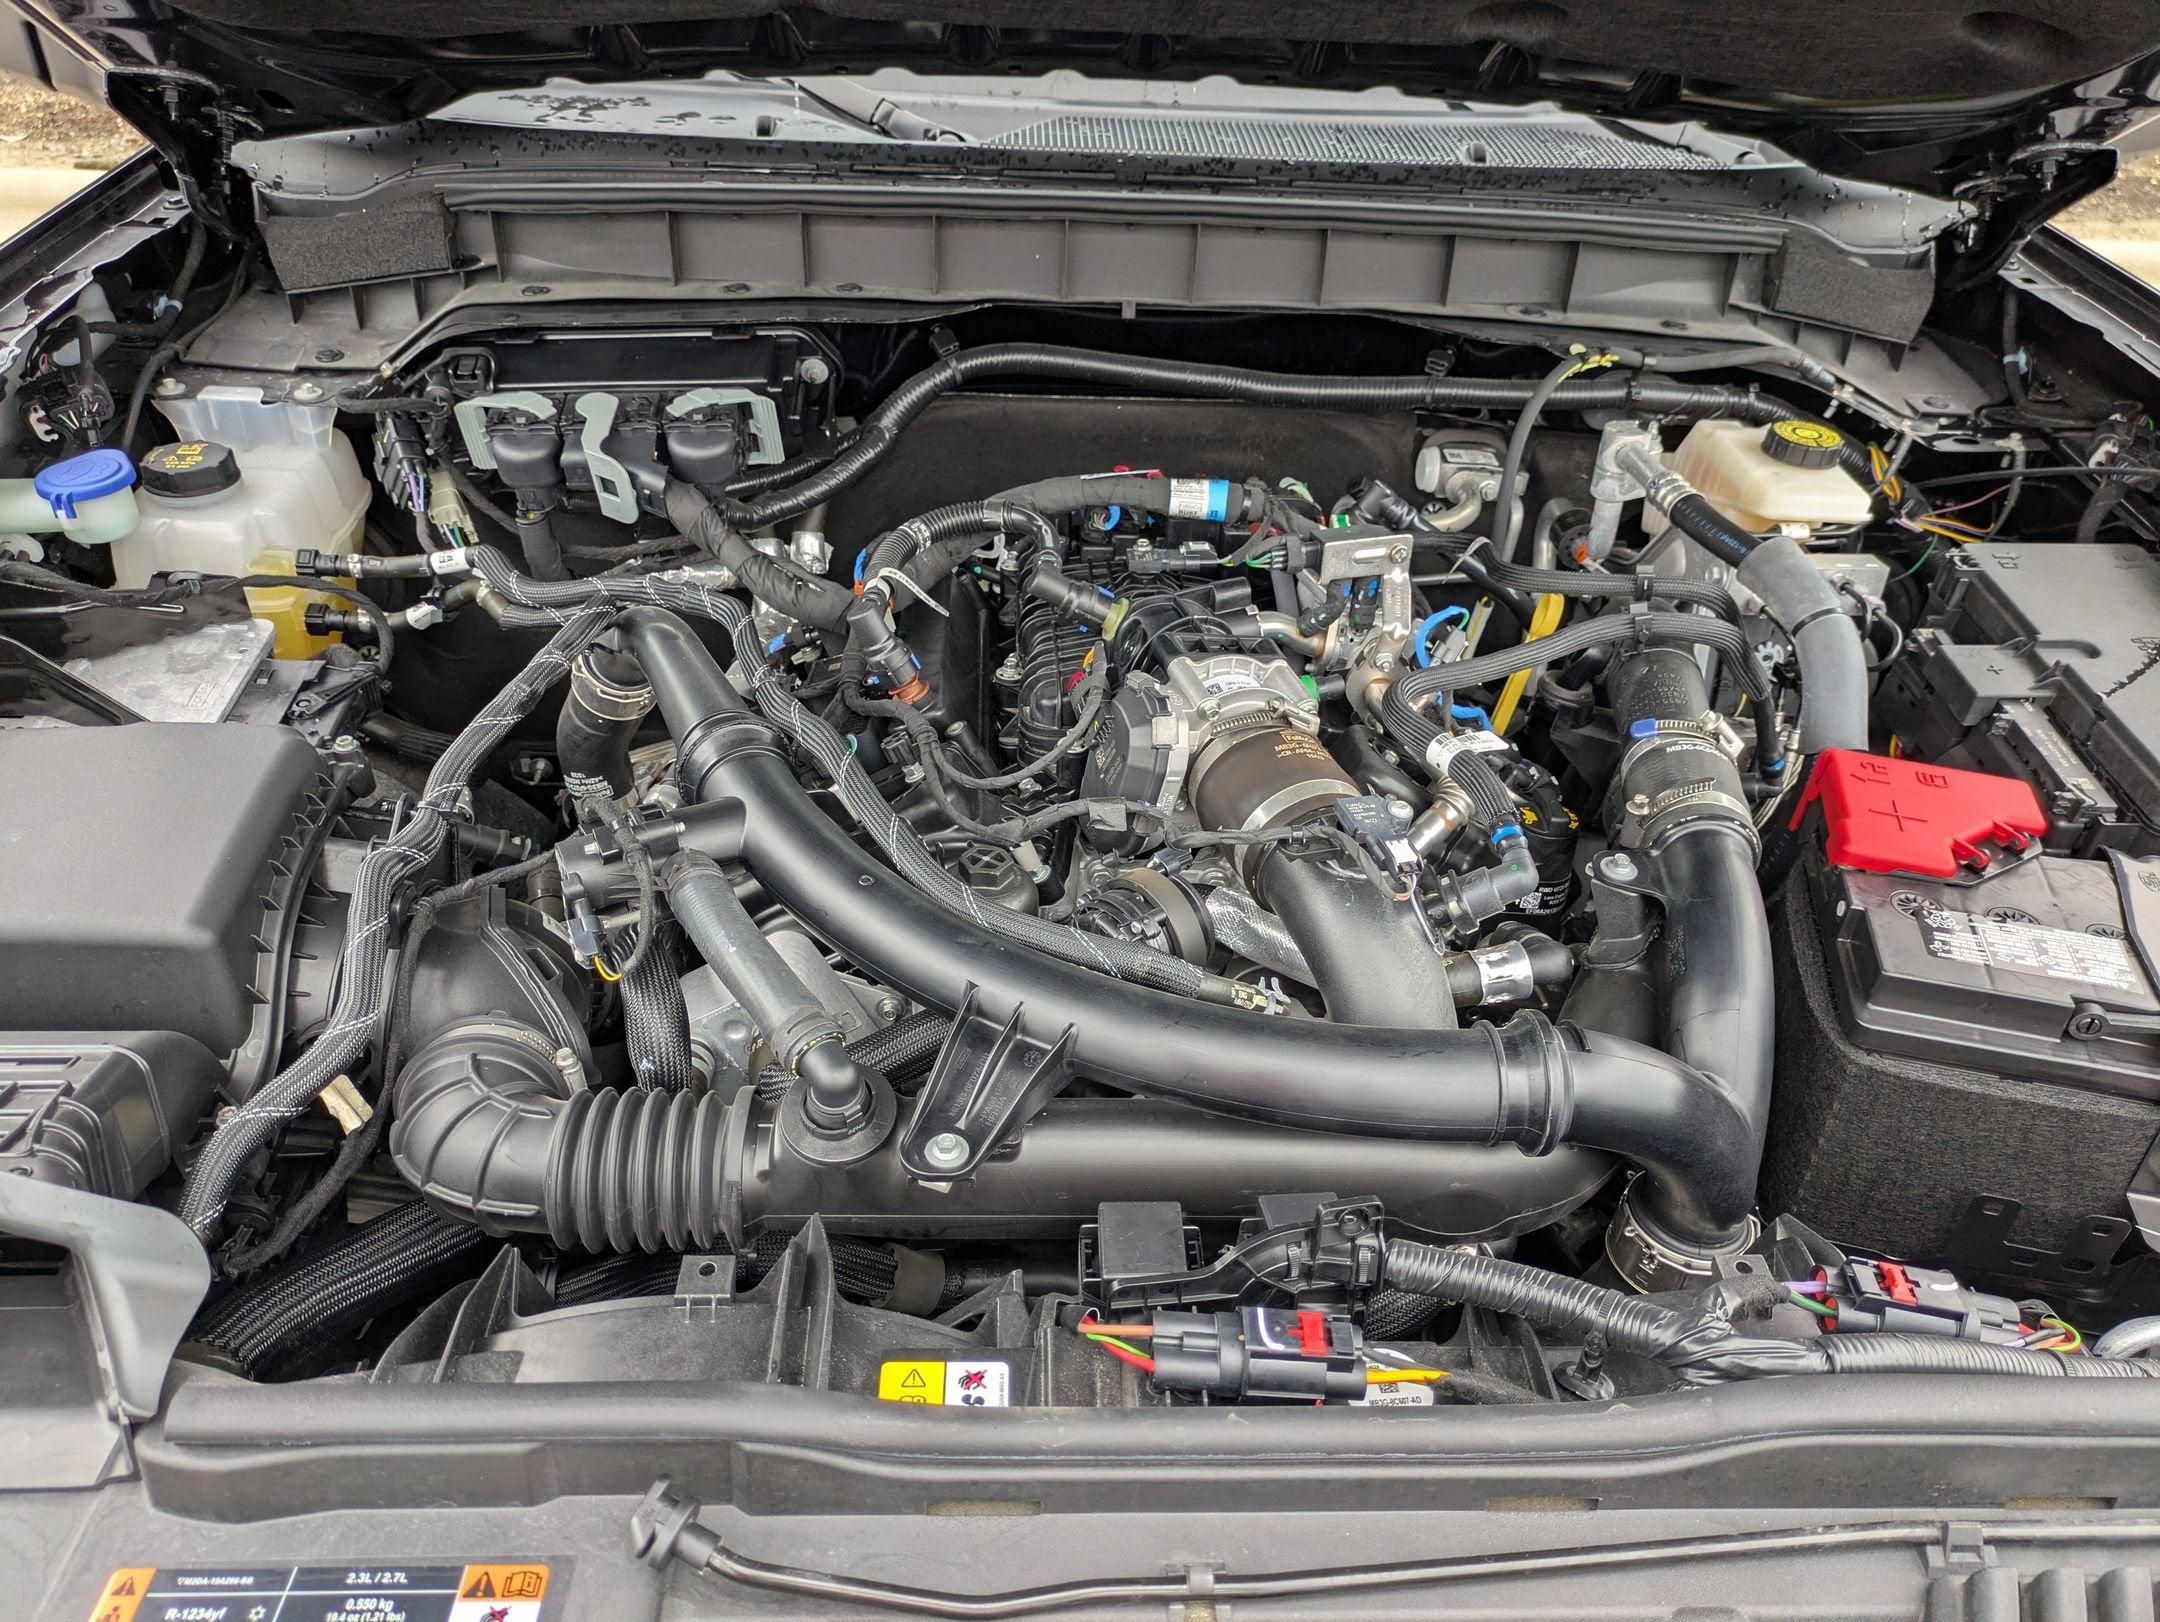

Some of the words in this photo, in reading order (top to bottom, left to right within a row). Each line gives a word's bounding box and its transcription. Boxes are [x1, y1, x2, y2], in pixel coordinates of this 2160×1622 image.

[345, 1571, 372, 1584] 2.3L
[381, 1571, 408, 1584] 2.7L
[345, 1597, 378, 1611] 0.550
[378, 1597, 394, 1612] kg
[164, 1606, 228, 1622] R-1234yf
